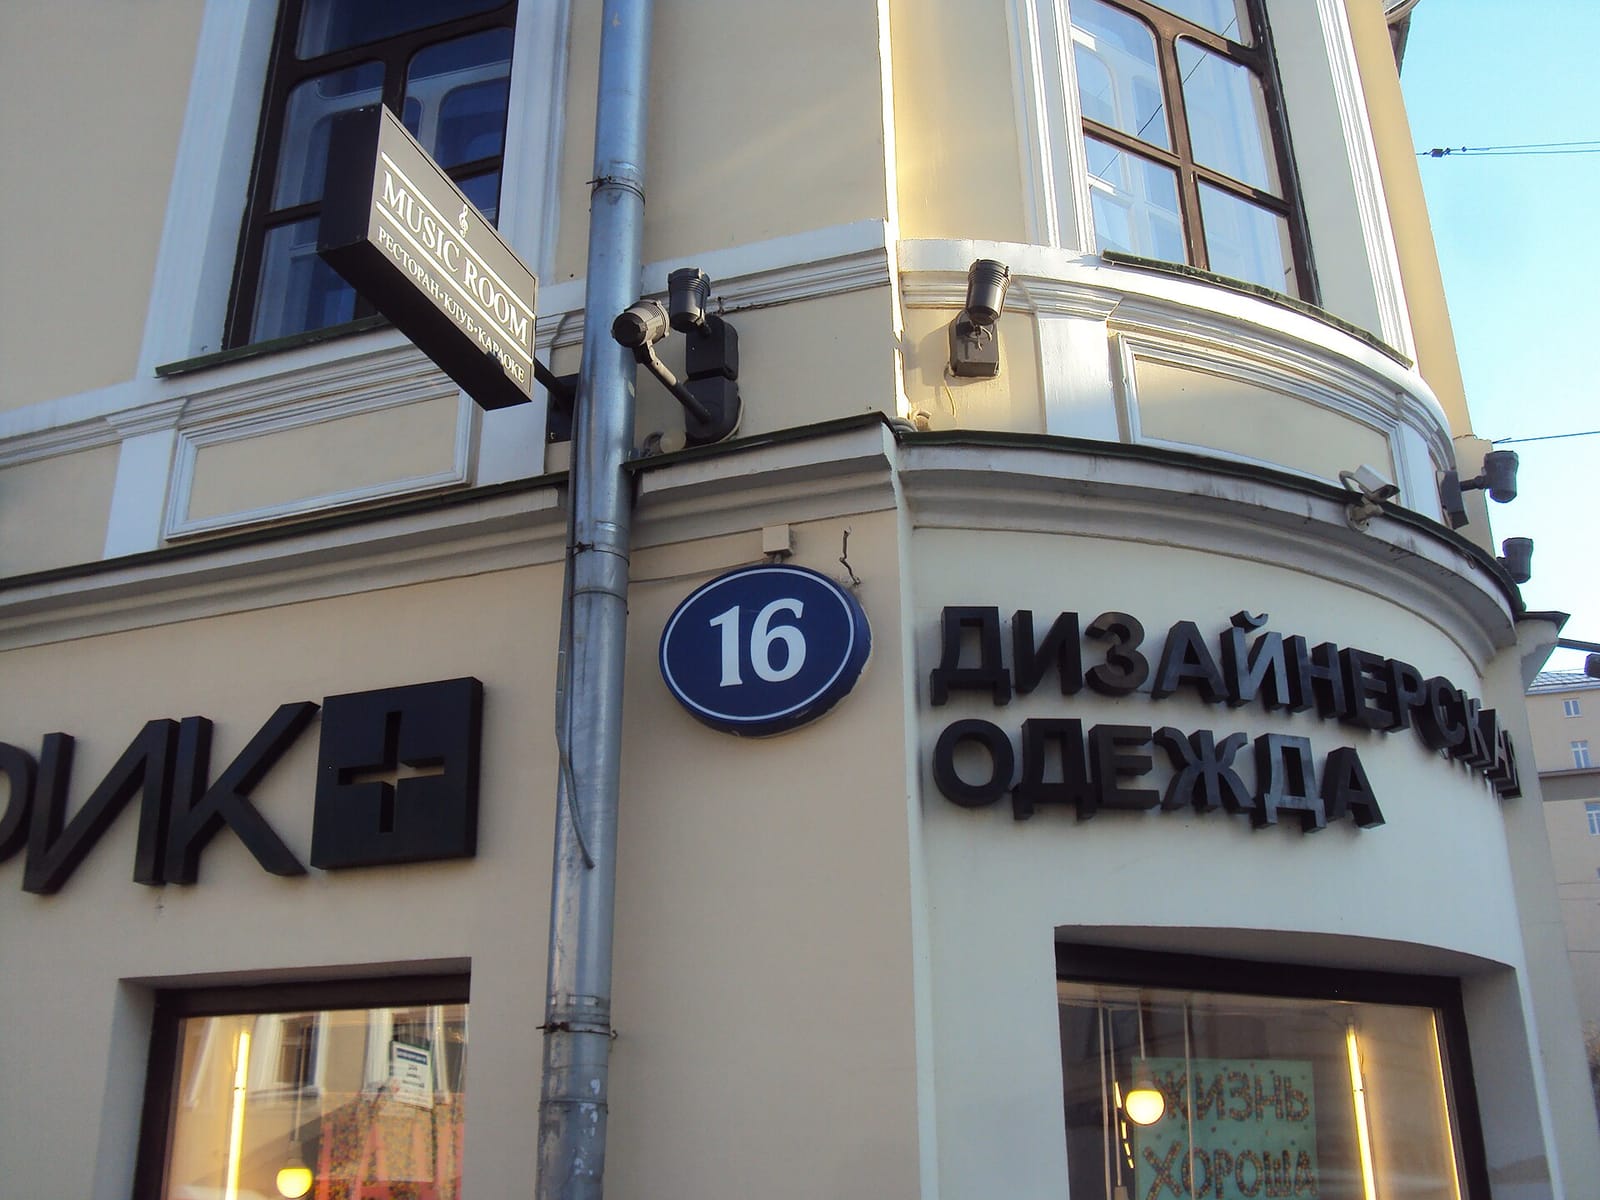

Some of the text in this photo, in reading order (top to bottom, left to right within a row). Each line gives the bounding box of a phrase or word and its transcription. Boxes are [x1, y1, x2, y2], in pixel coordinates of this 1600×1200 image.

[382, 171, 528, 346] MUSIC ROOM
[709, 598, 807, 687] 16
[932, 718, 1385, 833] ОДЕЖДА
[1143, 1141, 1318, 1200] ХОРОША
